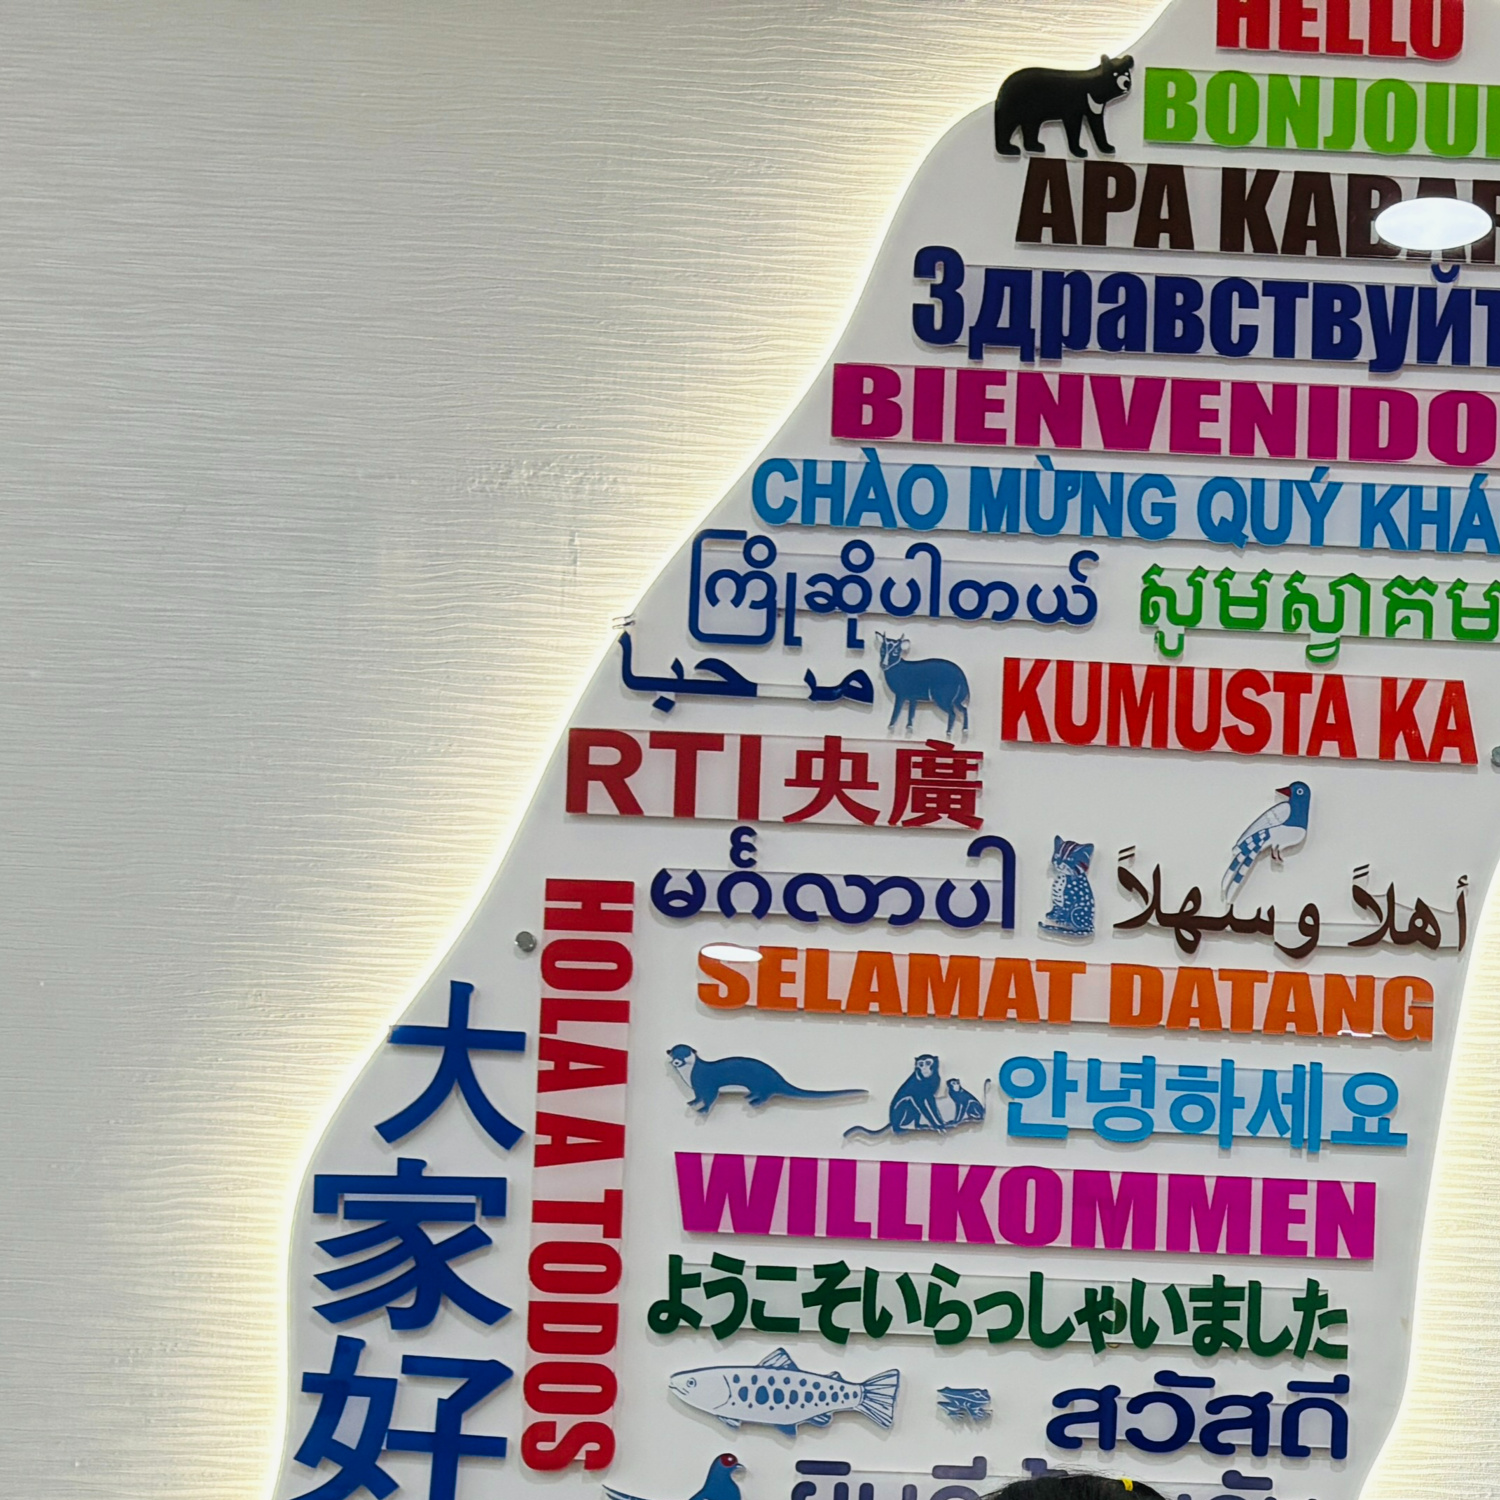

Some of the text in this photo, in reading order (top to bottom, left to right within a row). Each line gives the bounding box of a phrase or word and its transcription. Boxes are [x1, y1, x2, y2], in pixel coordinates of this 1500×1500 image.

[1216, 0, 1465, 60] HELLO
[1015, 156, 1195, 252] APA
[751, 448, 949, 533] CHÀO
[968, 455, 1178, 540] MỪNG
[1196, 466, 1341, 549] QUÝ
[1000, 656, 1479, 766] KUMUSTA KA
[565, 727, 762, 822] RTI
[697, 942, 1434, 1042] SELAMAT DATANG
[998, 1050, 1408, 1154] 안녕하세요
[520, 878, 635, 1472] HOLA A TODOS
[674, 1151, 1377, 1260] WILLKOMMEN
[647, 1253, 1349, 1361] ようこそいらっしゃいました
[1046, 1369, 1350, 1460] สวัสดี
